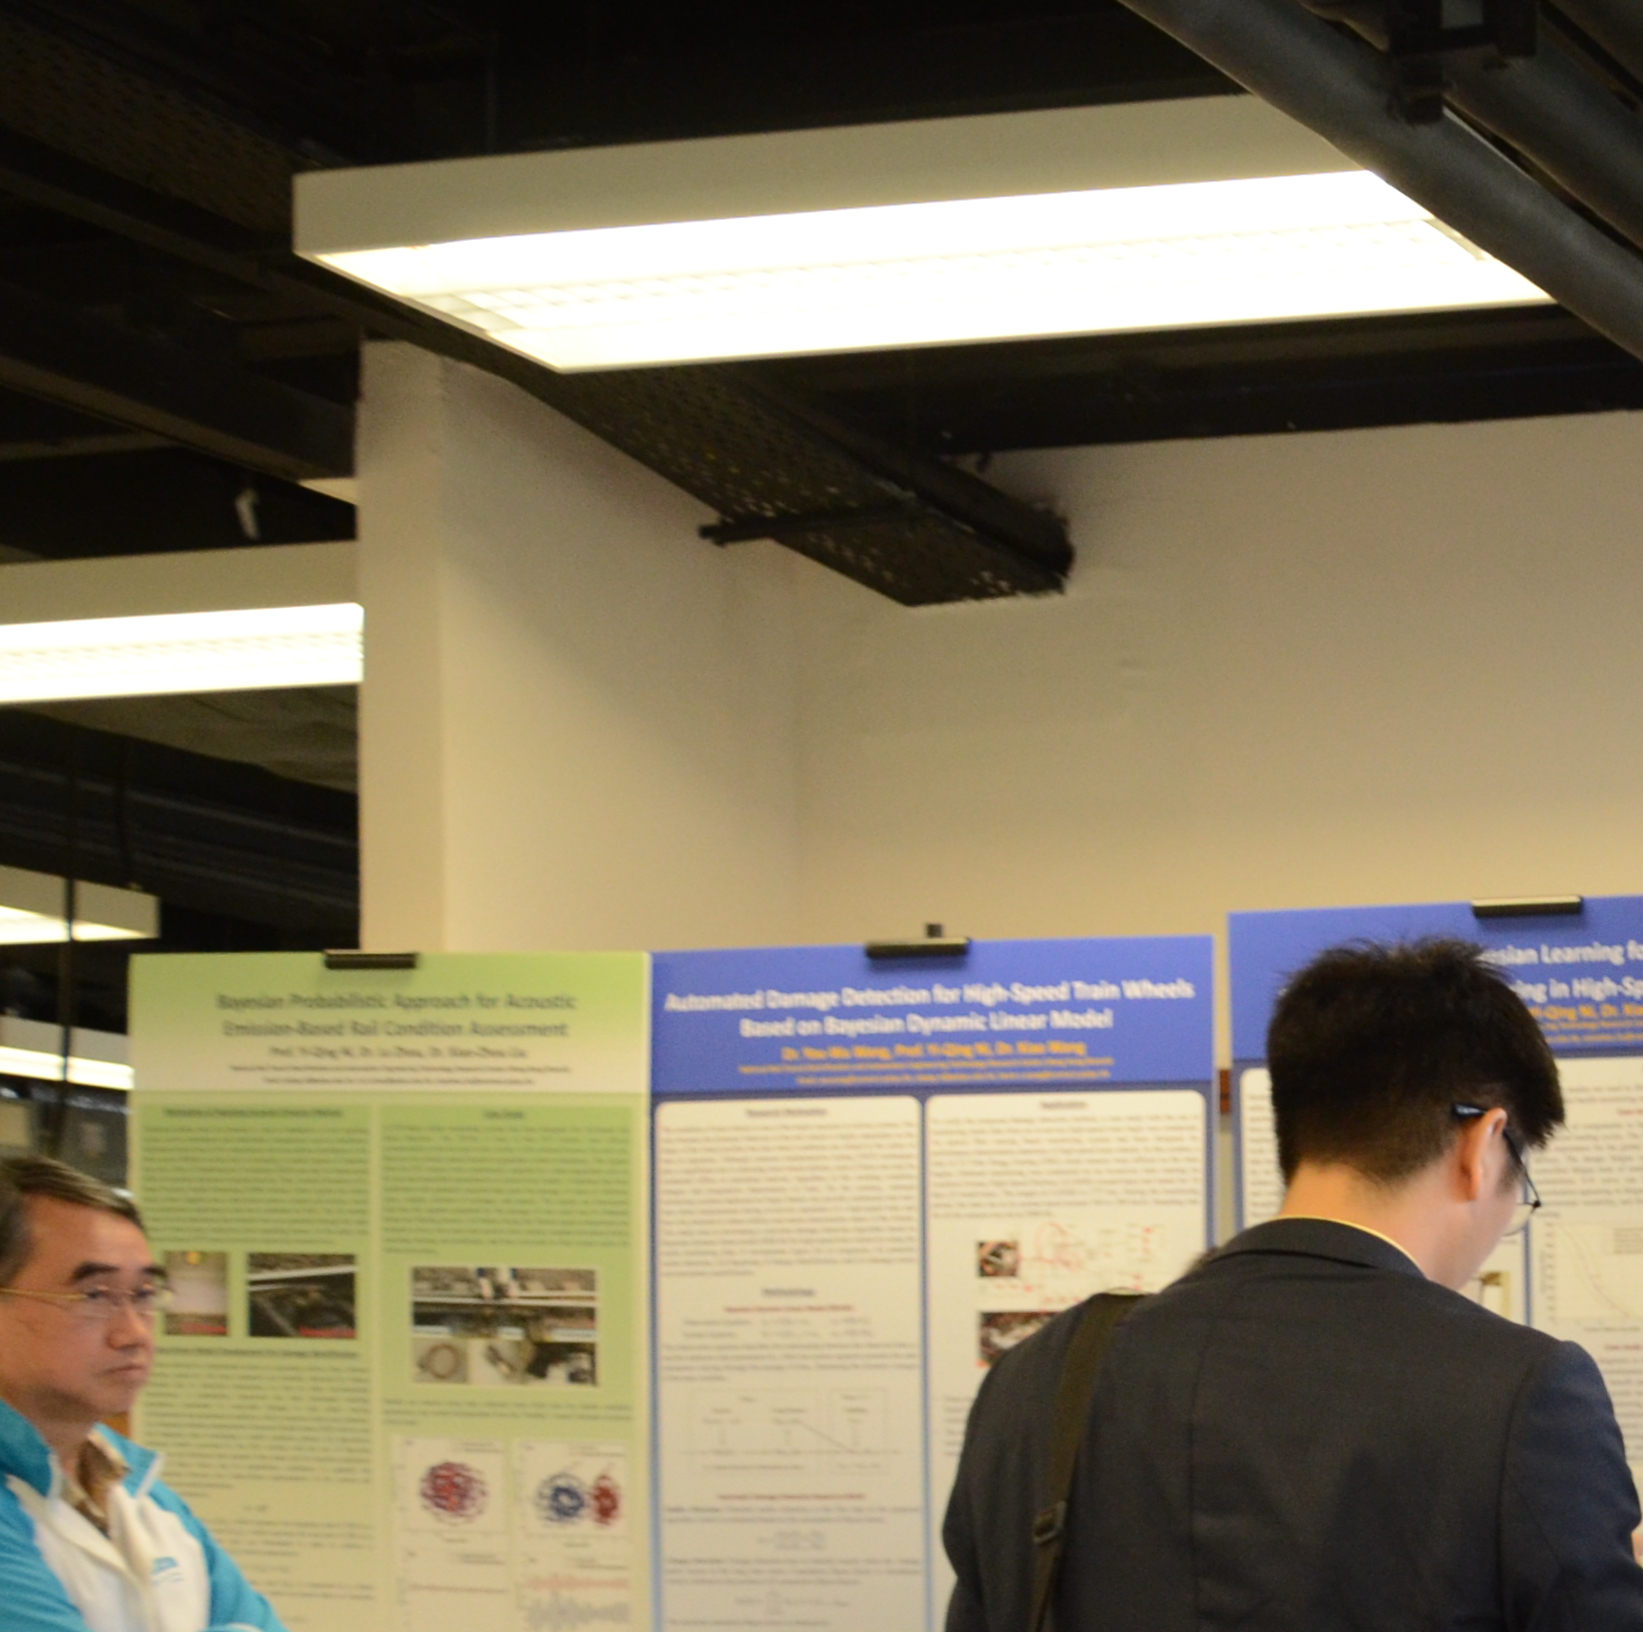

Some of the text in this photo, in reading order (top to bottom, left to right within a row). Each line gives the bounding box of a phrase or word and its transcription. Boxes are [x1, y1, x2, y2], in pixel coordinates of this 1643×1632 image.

[1541, 942, 1624, 965] Learning
[664, 978, 1196, 1011] Automated Damage Detection for High-Speed Train Wheels
[1550, 977, 1570, 998] in
[739, 1008, 1114, 1037] Based on Bayesian Dynamic Linear Model
